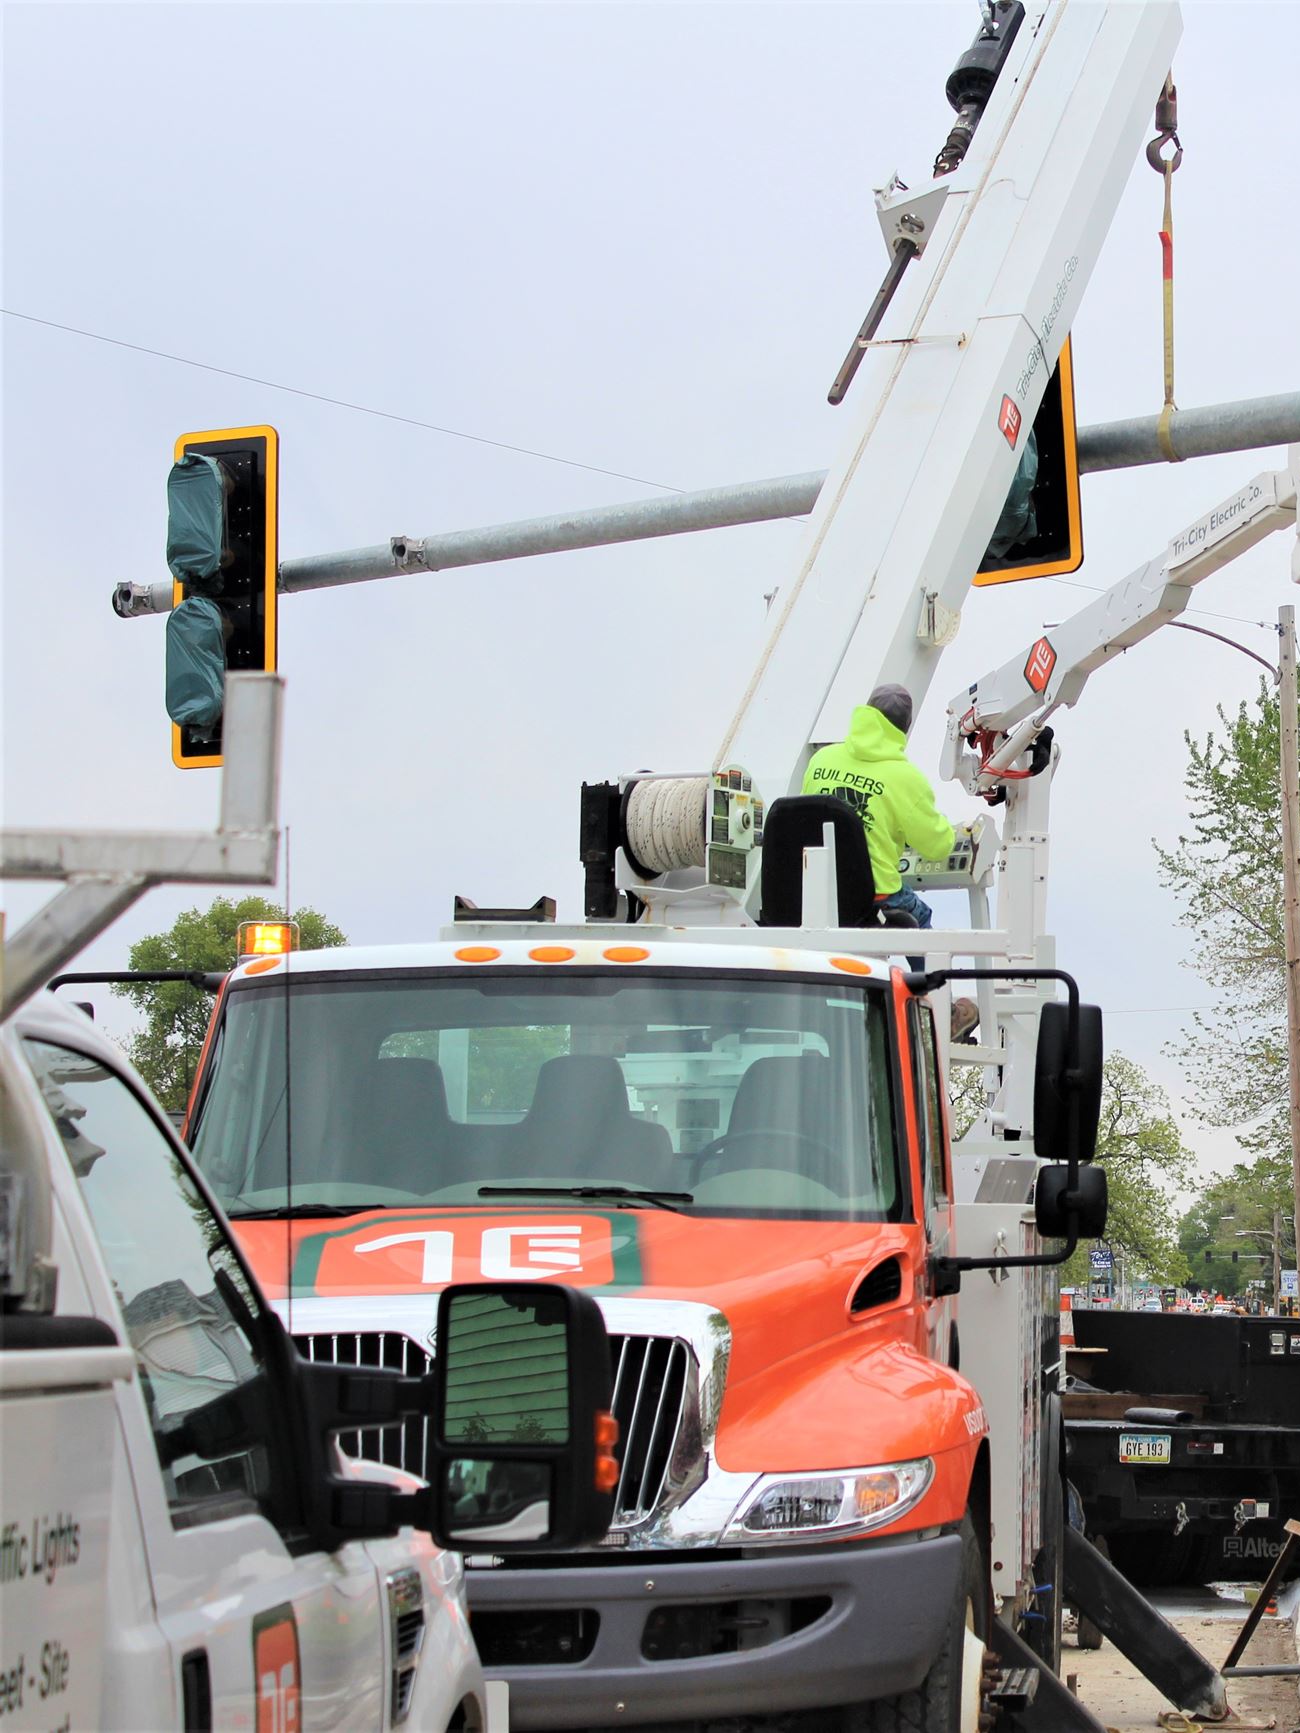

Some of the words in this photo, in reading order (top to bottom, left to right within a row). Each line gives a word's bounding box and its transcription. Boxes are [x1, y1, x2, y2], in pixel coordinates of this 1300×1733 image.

[1016, 338, 1043, 400] Tri-City
[1173, 524, 1207, 556] Tri-City
[1209, 496, 1246, 530] Electric
[813, 767, 885, 795] BUILDERS
[1126, 1441, 1143, 1456] GYE
[1147, 1442, 1163, 1456] 193
[32, 1511, 80, 1586] Lights
[40, 1638, 69, 1701] Site
